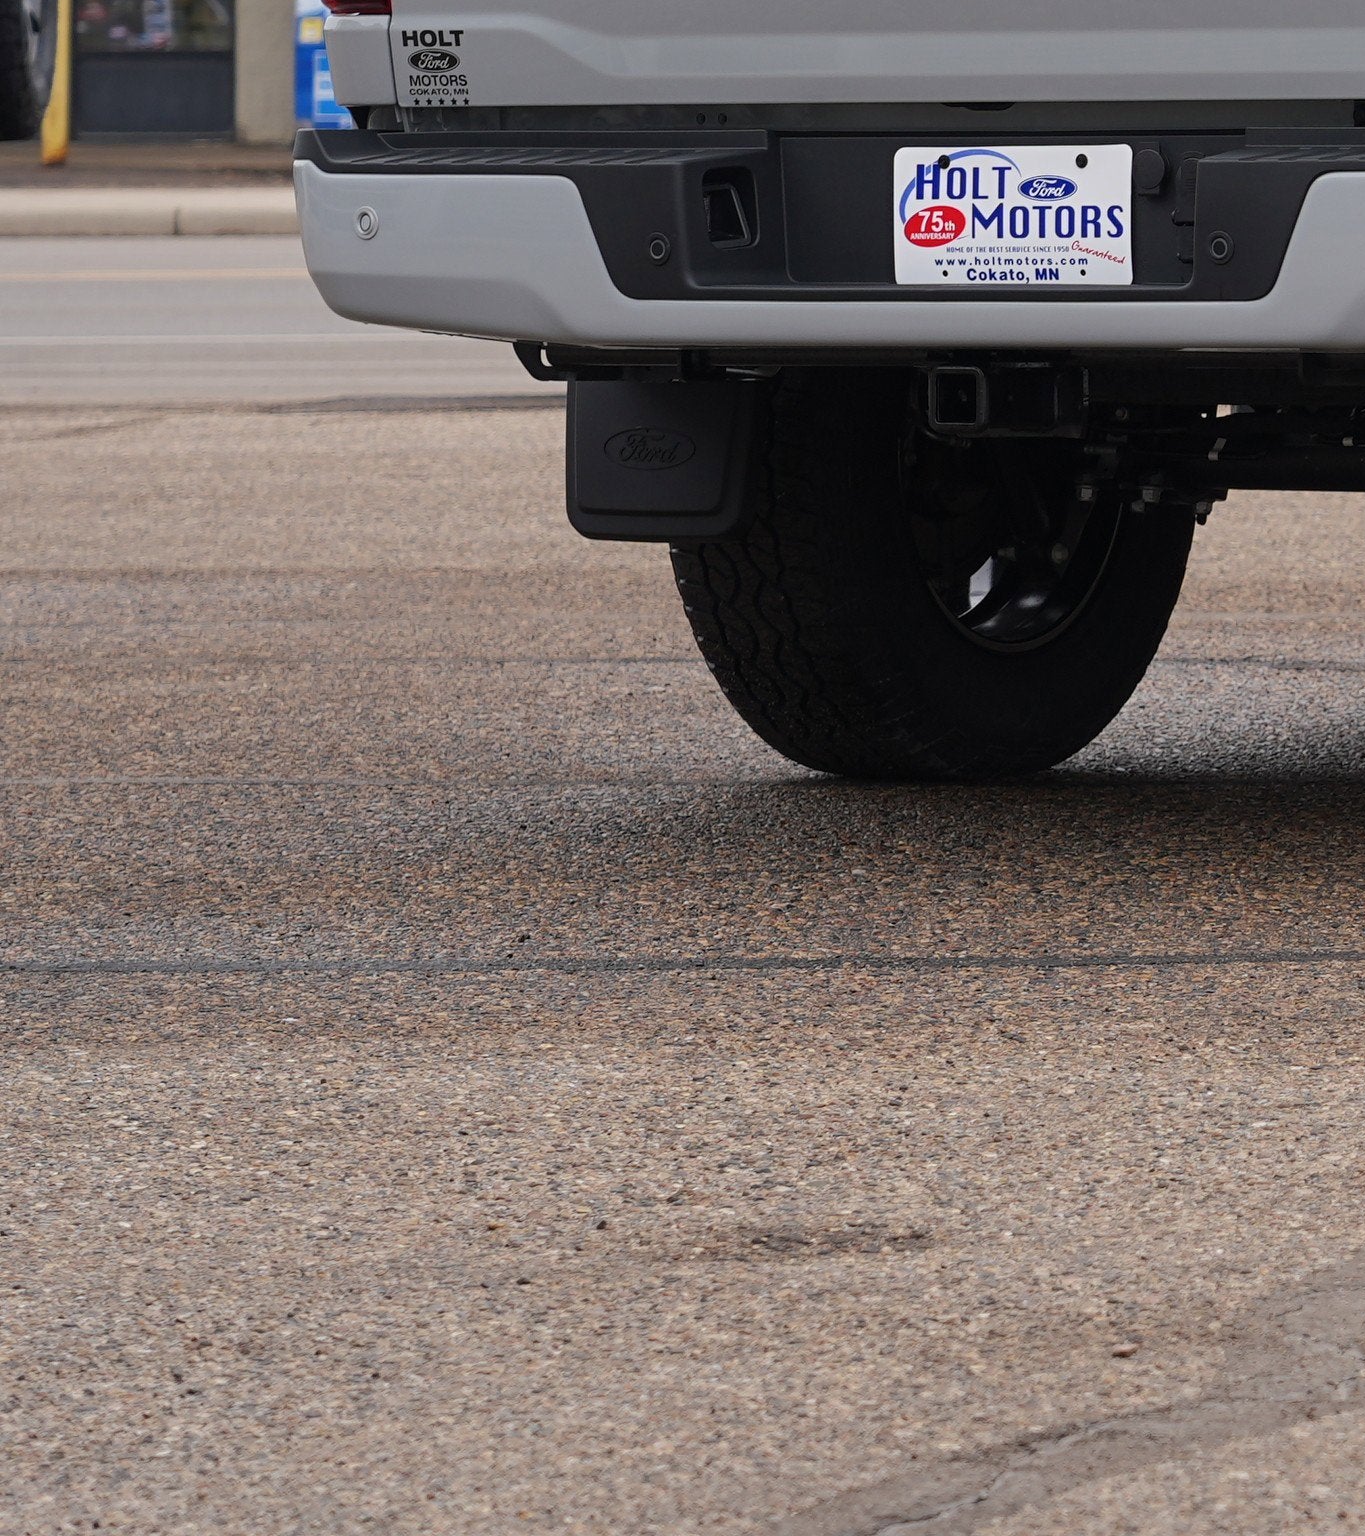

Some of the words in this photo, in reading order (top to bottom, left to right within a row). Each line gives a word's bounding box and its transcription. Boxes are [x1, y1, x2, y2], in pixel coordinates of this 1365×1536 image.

[401, 29, 464, 47] HOLT
[418, 52, 450, 69] Ford
[409, 74, 468, 87] MOTORS
[409, 88, 452, 96] COKATO,
[915, 163, 1012, 200] HOLT
[1028, 178, 1067, 197] Ford
[918, 210, 956, 232] 75th
[971, 202, 1124, 240] MOTORS
[910, 232, 955, 241] ANNIVERSARY
[946, 245, 964, 253] HOME
[966, 245, 974, 253] OF
[975, 245, 987, 253] THE
[989, 245, 1003, 253] BEST
[1004, 245, 1031, 253] SERVICE
[1032, 245, 1052, 253] SINCE
[1053, 245, 1069, 253] 1950
[1071, 240, 1126, 265] Guaranteed
[934, 256, 1088, 266] www.holtmotors.com
[966, 268, 1030, 284] Cokato,
[1035, 268, 1060, 281] MN
[620, 433, 681, 463] Ford
